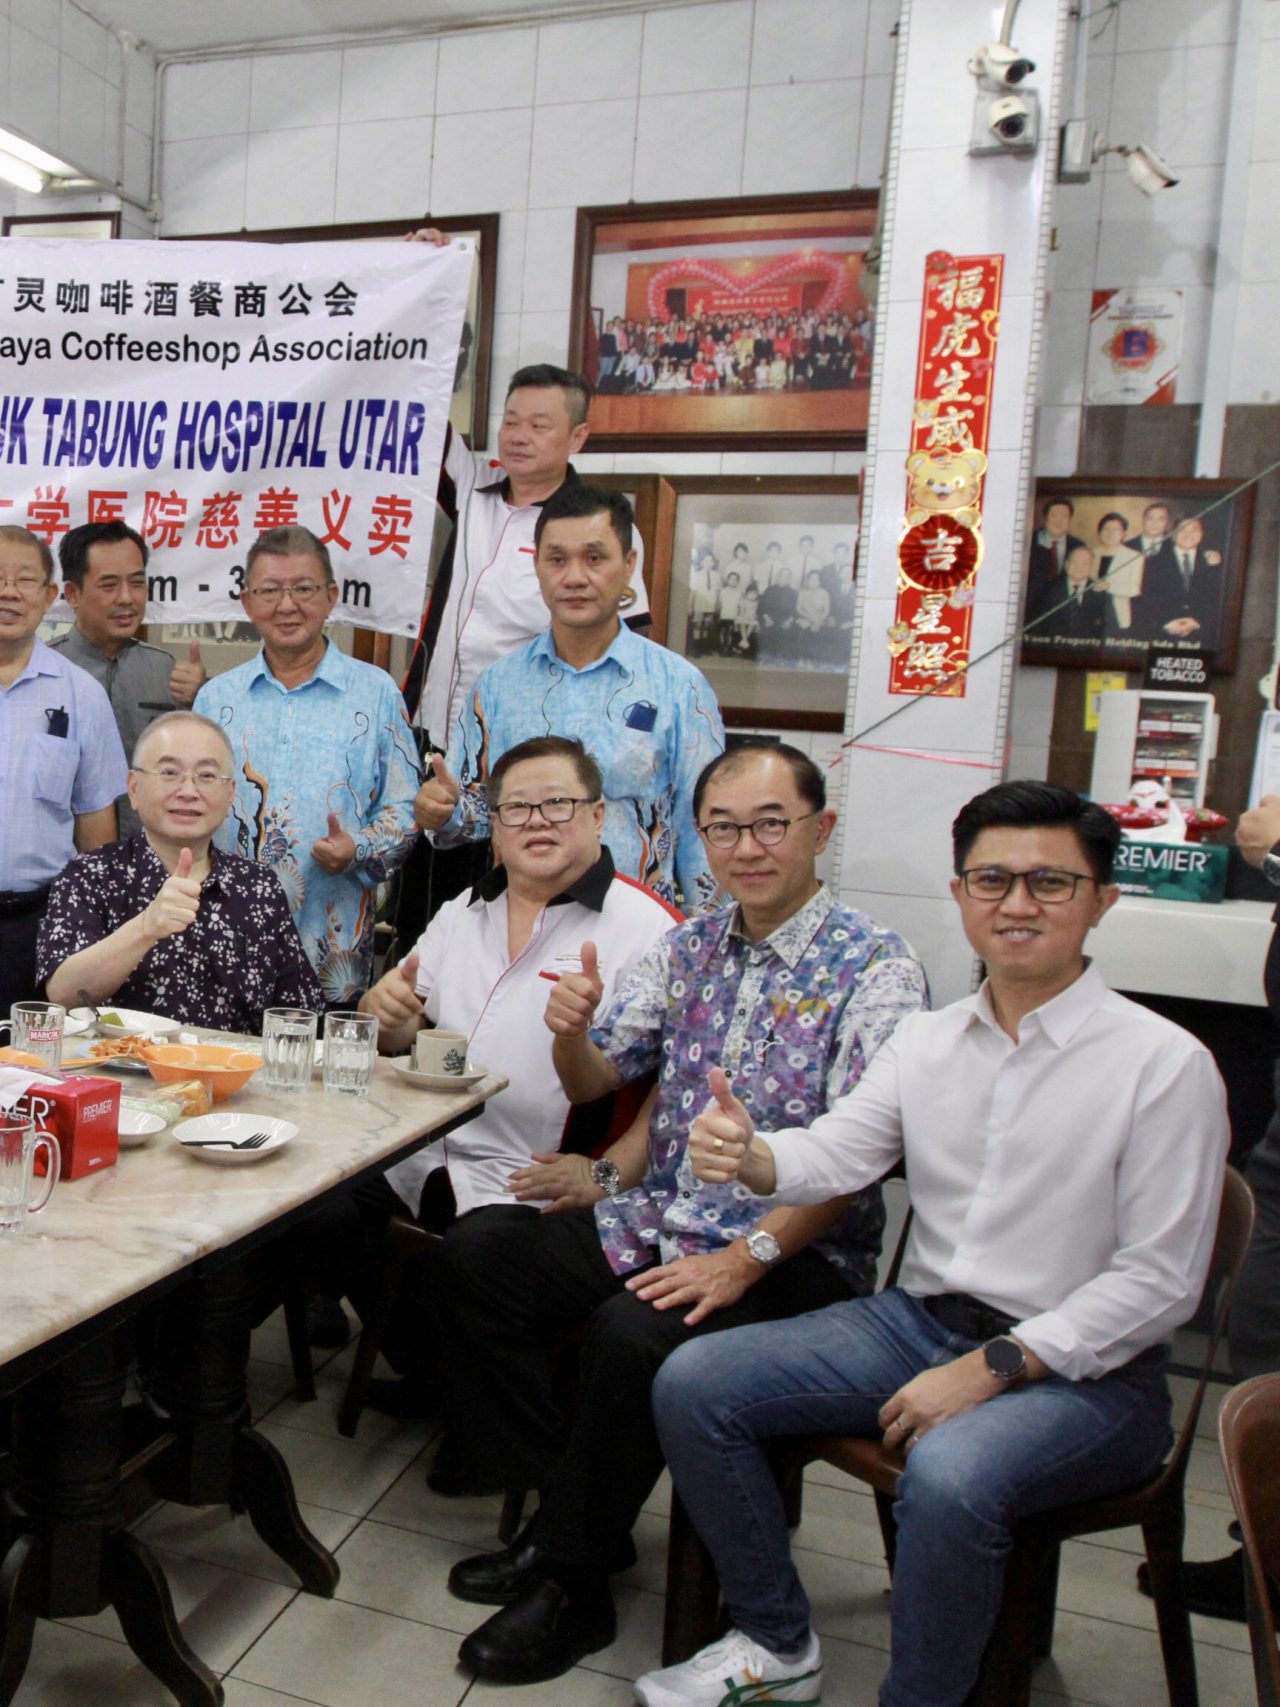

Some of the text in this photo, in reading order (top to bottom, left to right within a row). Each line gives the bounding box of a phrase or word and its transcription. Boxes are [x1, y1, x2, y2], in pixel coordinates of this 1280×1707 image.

[61, 331, 241, 370] Coffeeshop
[249, 331, 427, 364] Association
[42, 397, 168, 469] TABUNG
[174, 399, 327, 473] HOSPITAL
[338, 398, 425, 476] UTAR
[1150, 667, 1206, 684] TOBACCO
[1156, 656, 1203, 671] HEATED
[1113, 845, 1205, 873] REMIER
[83, 1099, 113, 1120] PREMIER
